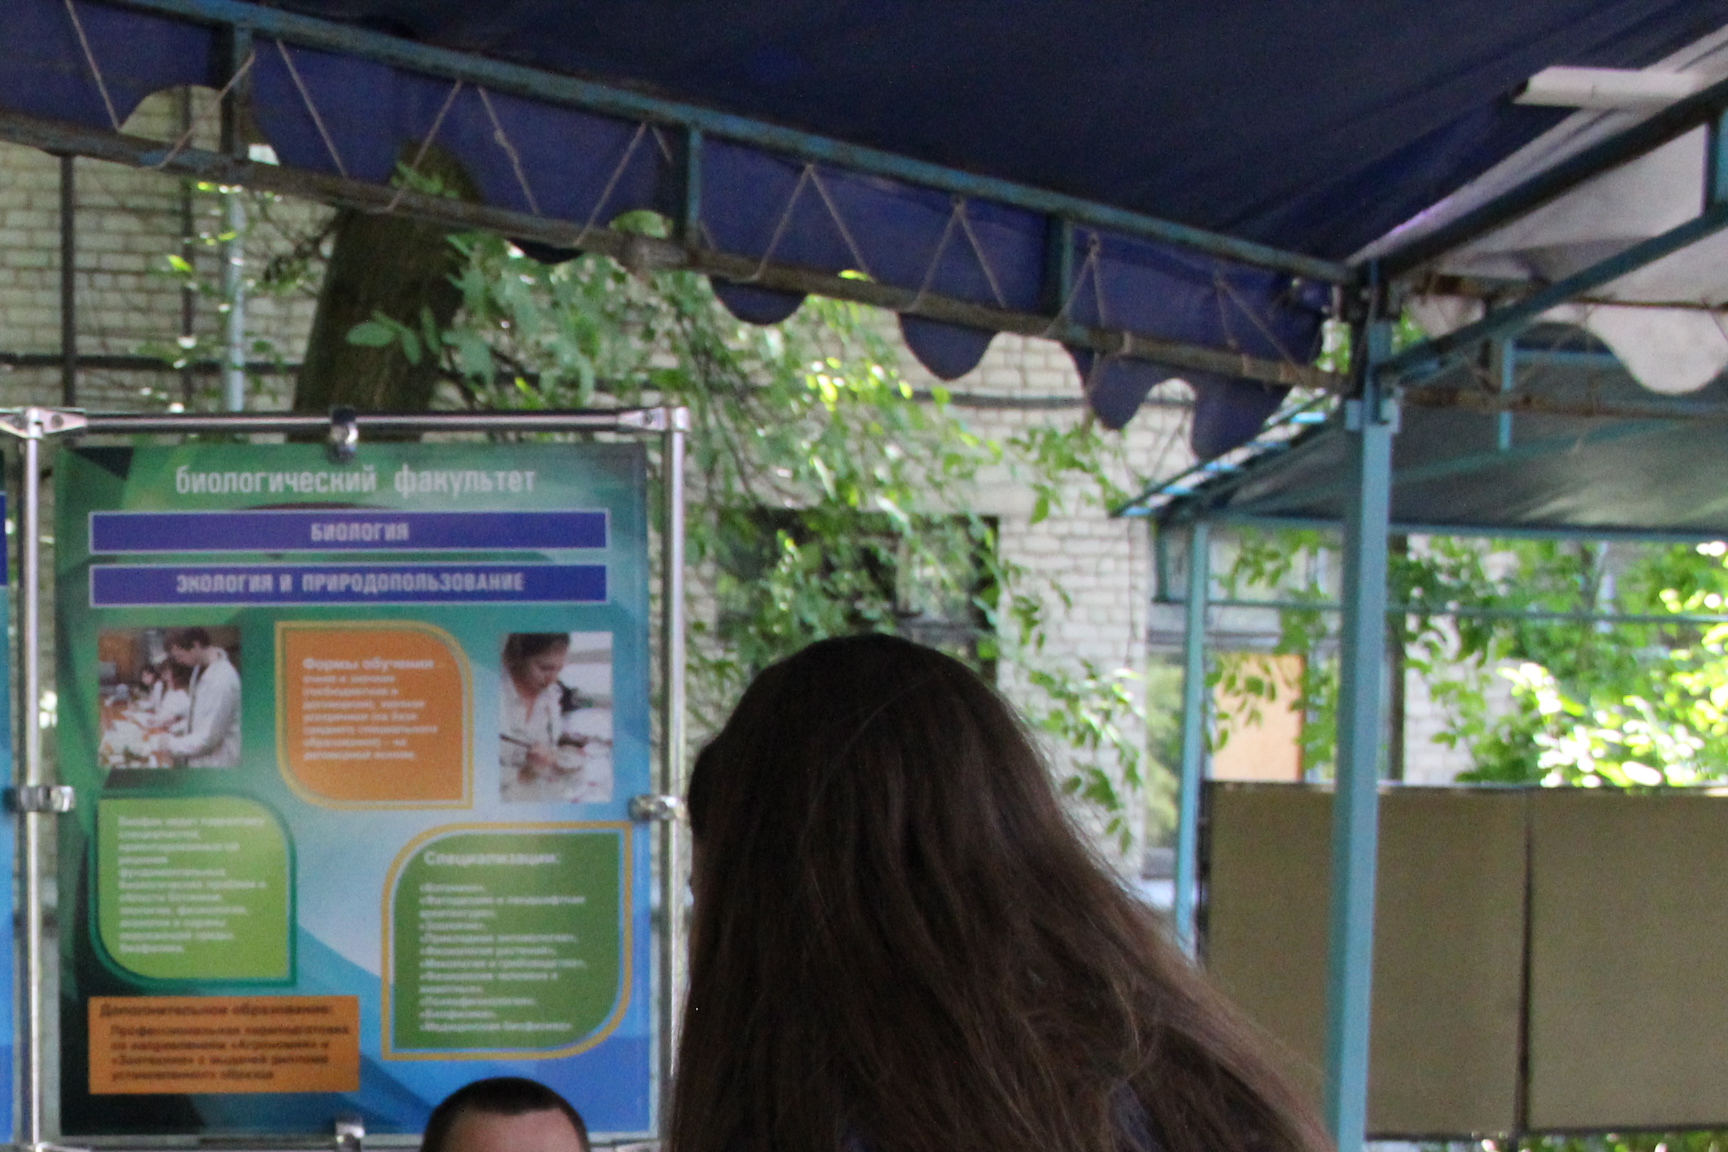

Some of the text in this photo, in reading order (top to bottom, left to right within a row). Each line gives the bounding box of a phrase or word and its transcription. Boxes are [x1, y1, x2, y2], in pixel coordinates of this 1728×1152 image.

[176, 463, 536, 499] биологический факультет
[310, 522, 409, 542] БИОЛОГИЯ
[176, 574, 272, 594] ЭКОЛОГИЯ
[301, 573, 524, 595] ПРИРОДОПОЛЬЗОВАНИЕ
[303, 658, 359, 671] Формы
